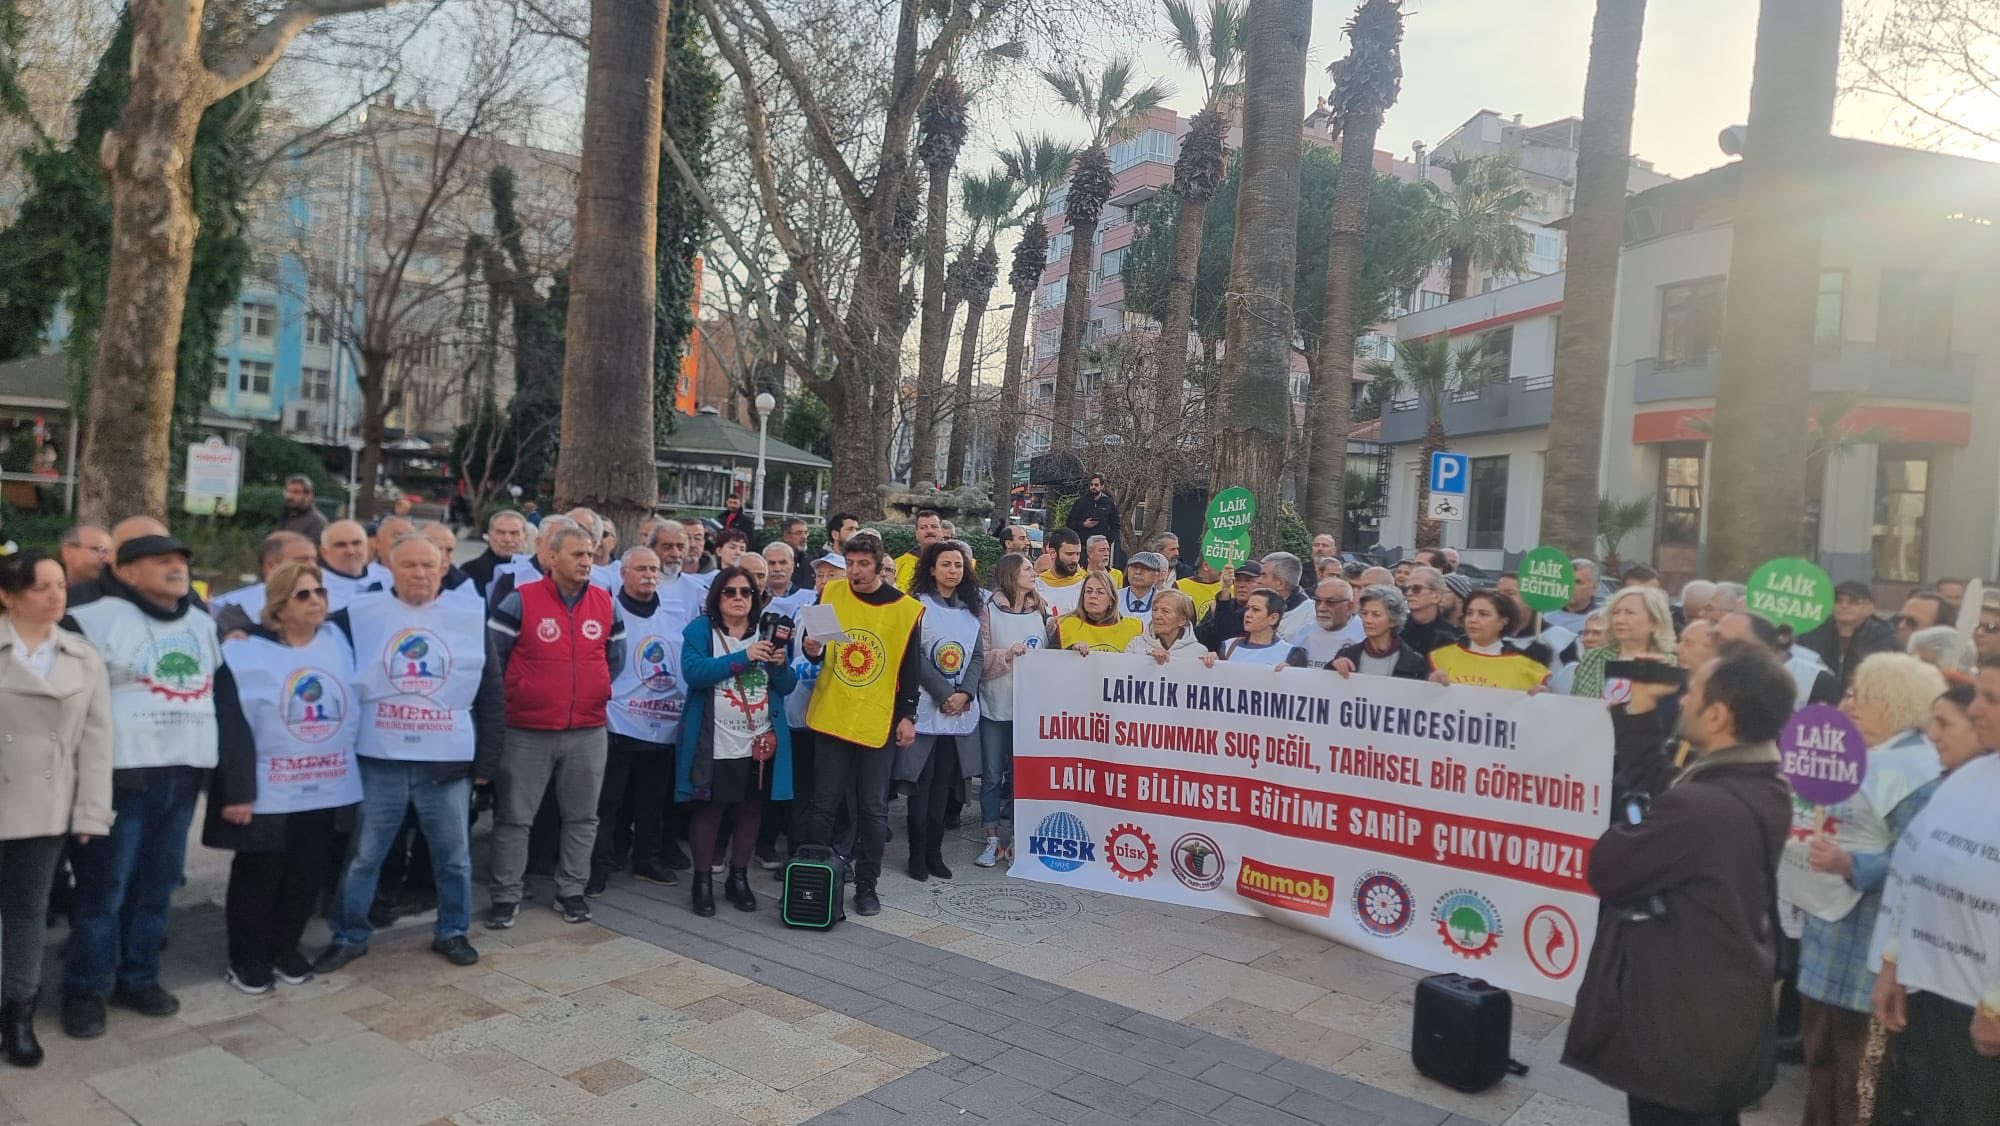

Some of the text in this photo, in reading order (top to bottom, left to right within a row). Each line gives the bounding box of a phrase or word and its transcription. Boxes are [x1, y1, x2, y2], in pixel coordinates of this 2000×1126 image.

[1438, 457, 1460, 489] P
[1219, 496, 1247, 513] LAİK
[1212, 512, 1251, 530] YAŞAM
[1205, 543, 1246, 561] EĞİTM
[1528, 559, 1563, 579] LAİK
[1520, 576, 1570, 600] EĞİTİM
[1767, 571, 1817, 598] LAİK
[1751, 590, 1824, 621] YAŞAM
[1103, 674, 1517, 750] LAİKLİK HAKLARIMIZIN GÜVENCESİDİR!
[1796, 720, 1847, 753] LAİK
[1039, 711, 1111, 745] LAİKLİĞİ
[1114, 720, 1219, 756] SAVUNMAK
[1224, 730, 1261, 769] SUÇ
[1265, 733, 1321, 774] DEĞİL,
[1329, 745, 1423, 787] TARİHSEL
[1430, 756, 1467, 795] BİR
[1474, 763, 1586, 814] GÖREVDİR
[1783, 748, 1859, 785] EĞİTİM
[1049, 762, 1584, 880] LAİK VE BİLİMSEL EĞİTİME SAHİP ÇIKIYORUZ!
[1029, 836, 1096, 863] KESK
[1116, 842, 1146, 861] DİSK
[1050, 860, 1070, 871] 1995
[1241, 864, 1329, 902] tmmob
